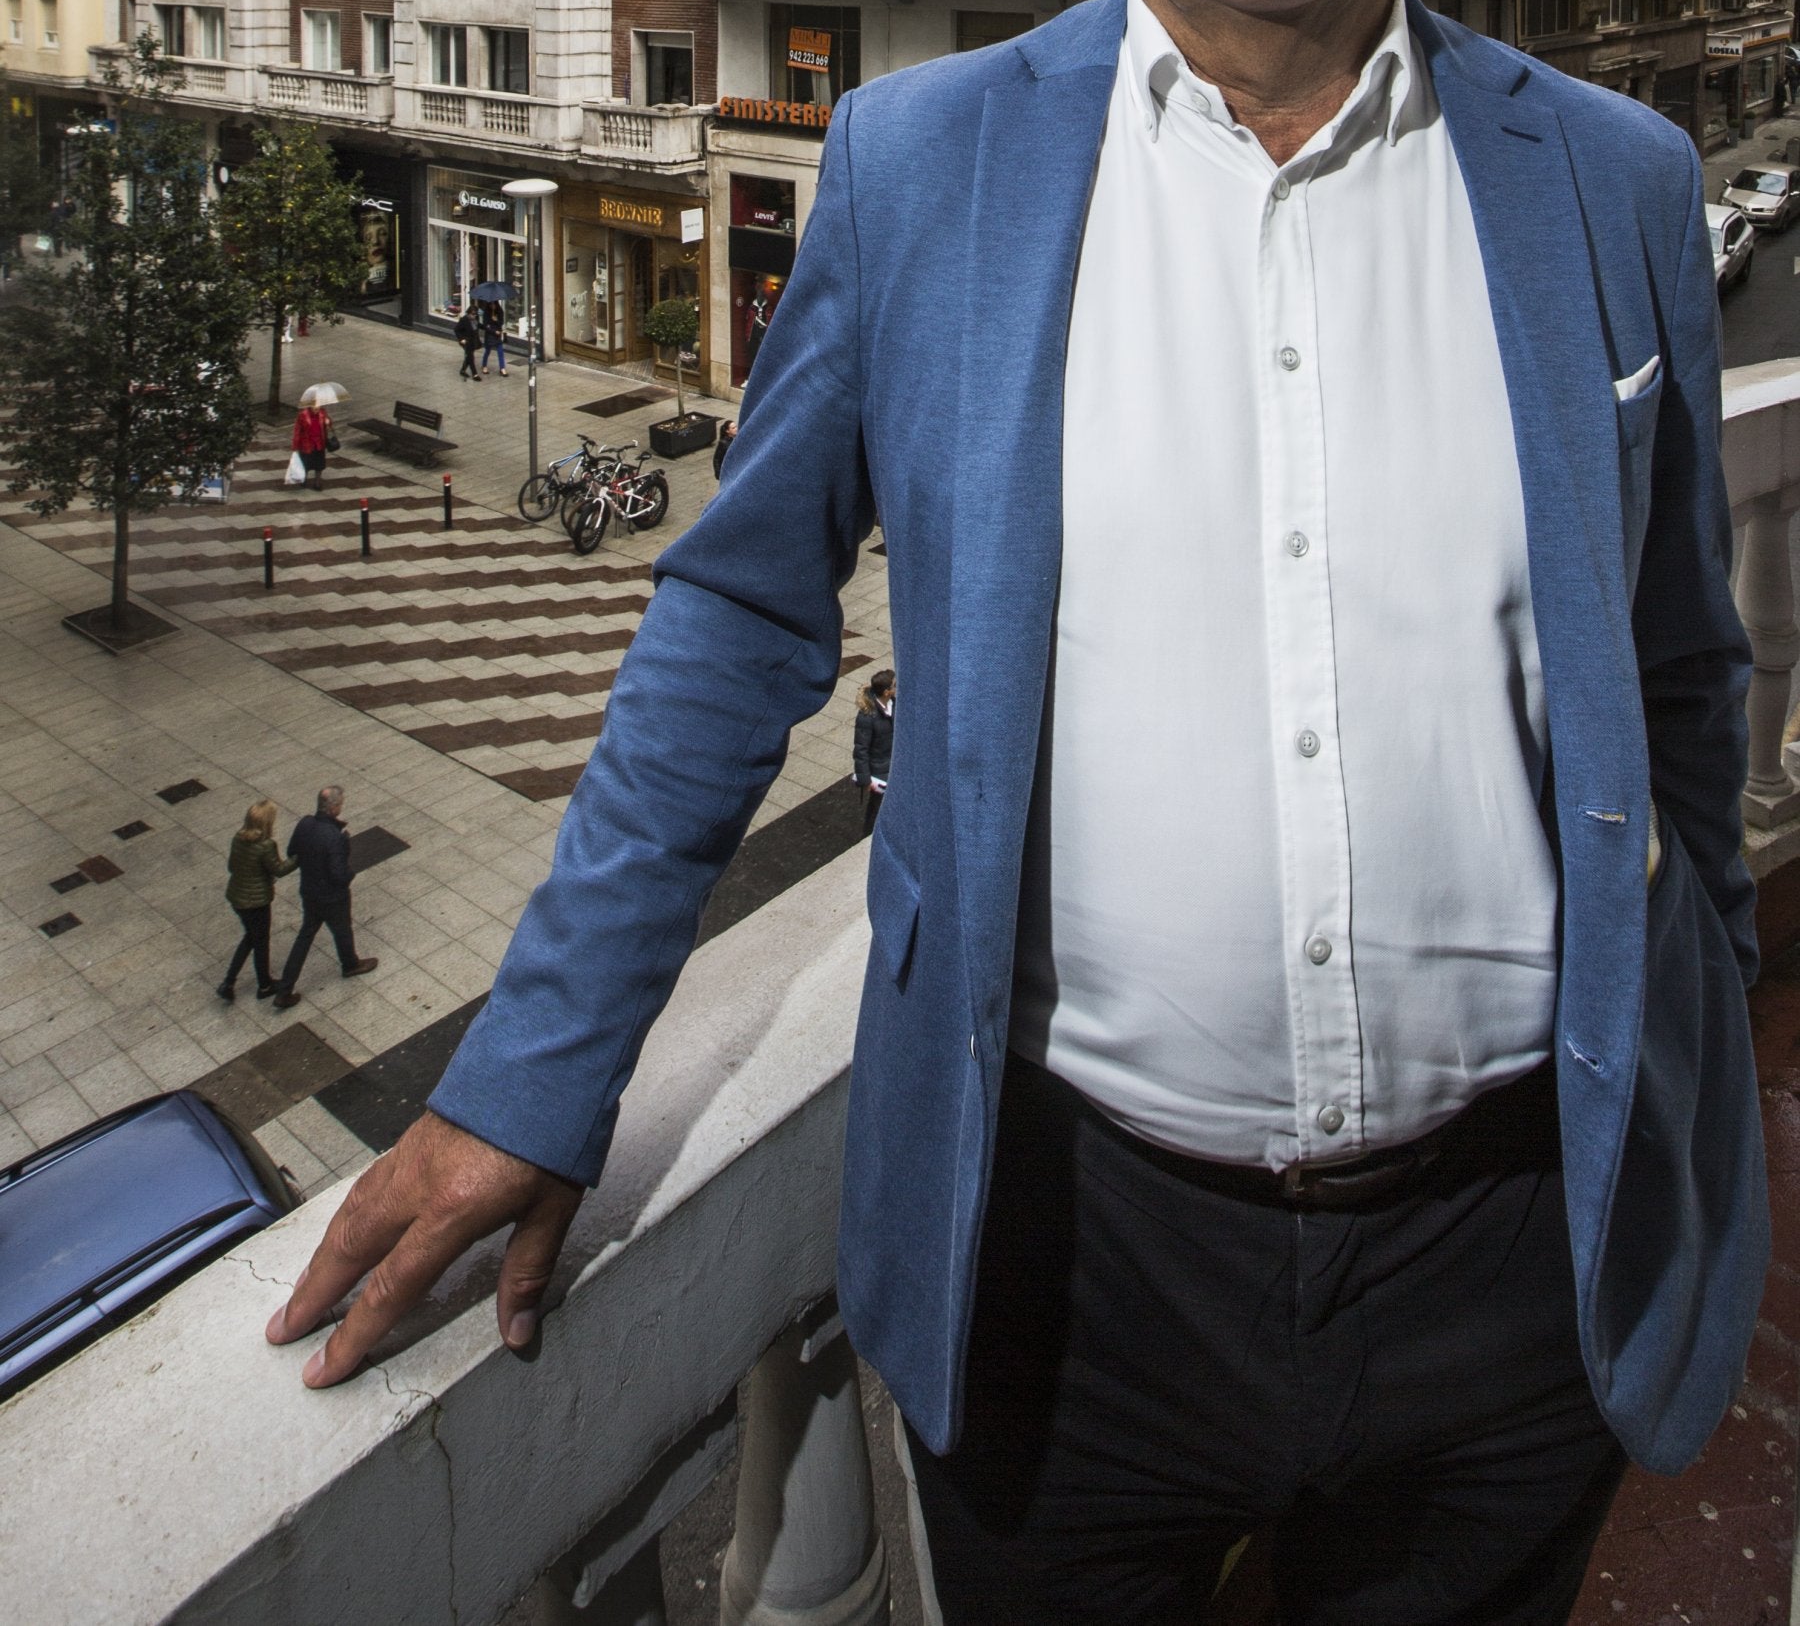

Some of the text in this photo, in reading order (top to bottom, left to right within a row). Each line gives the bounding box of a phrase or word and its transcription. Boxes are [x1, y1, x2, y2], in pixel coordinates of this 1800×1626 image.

[789, 50, 829, 66] 942 223 669
[470, 196, 507, 211] EL GANSO
[600, 198, 662, 226] BROWNIE
